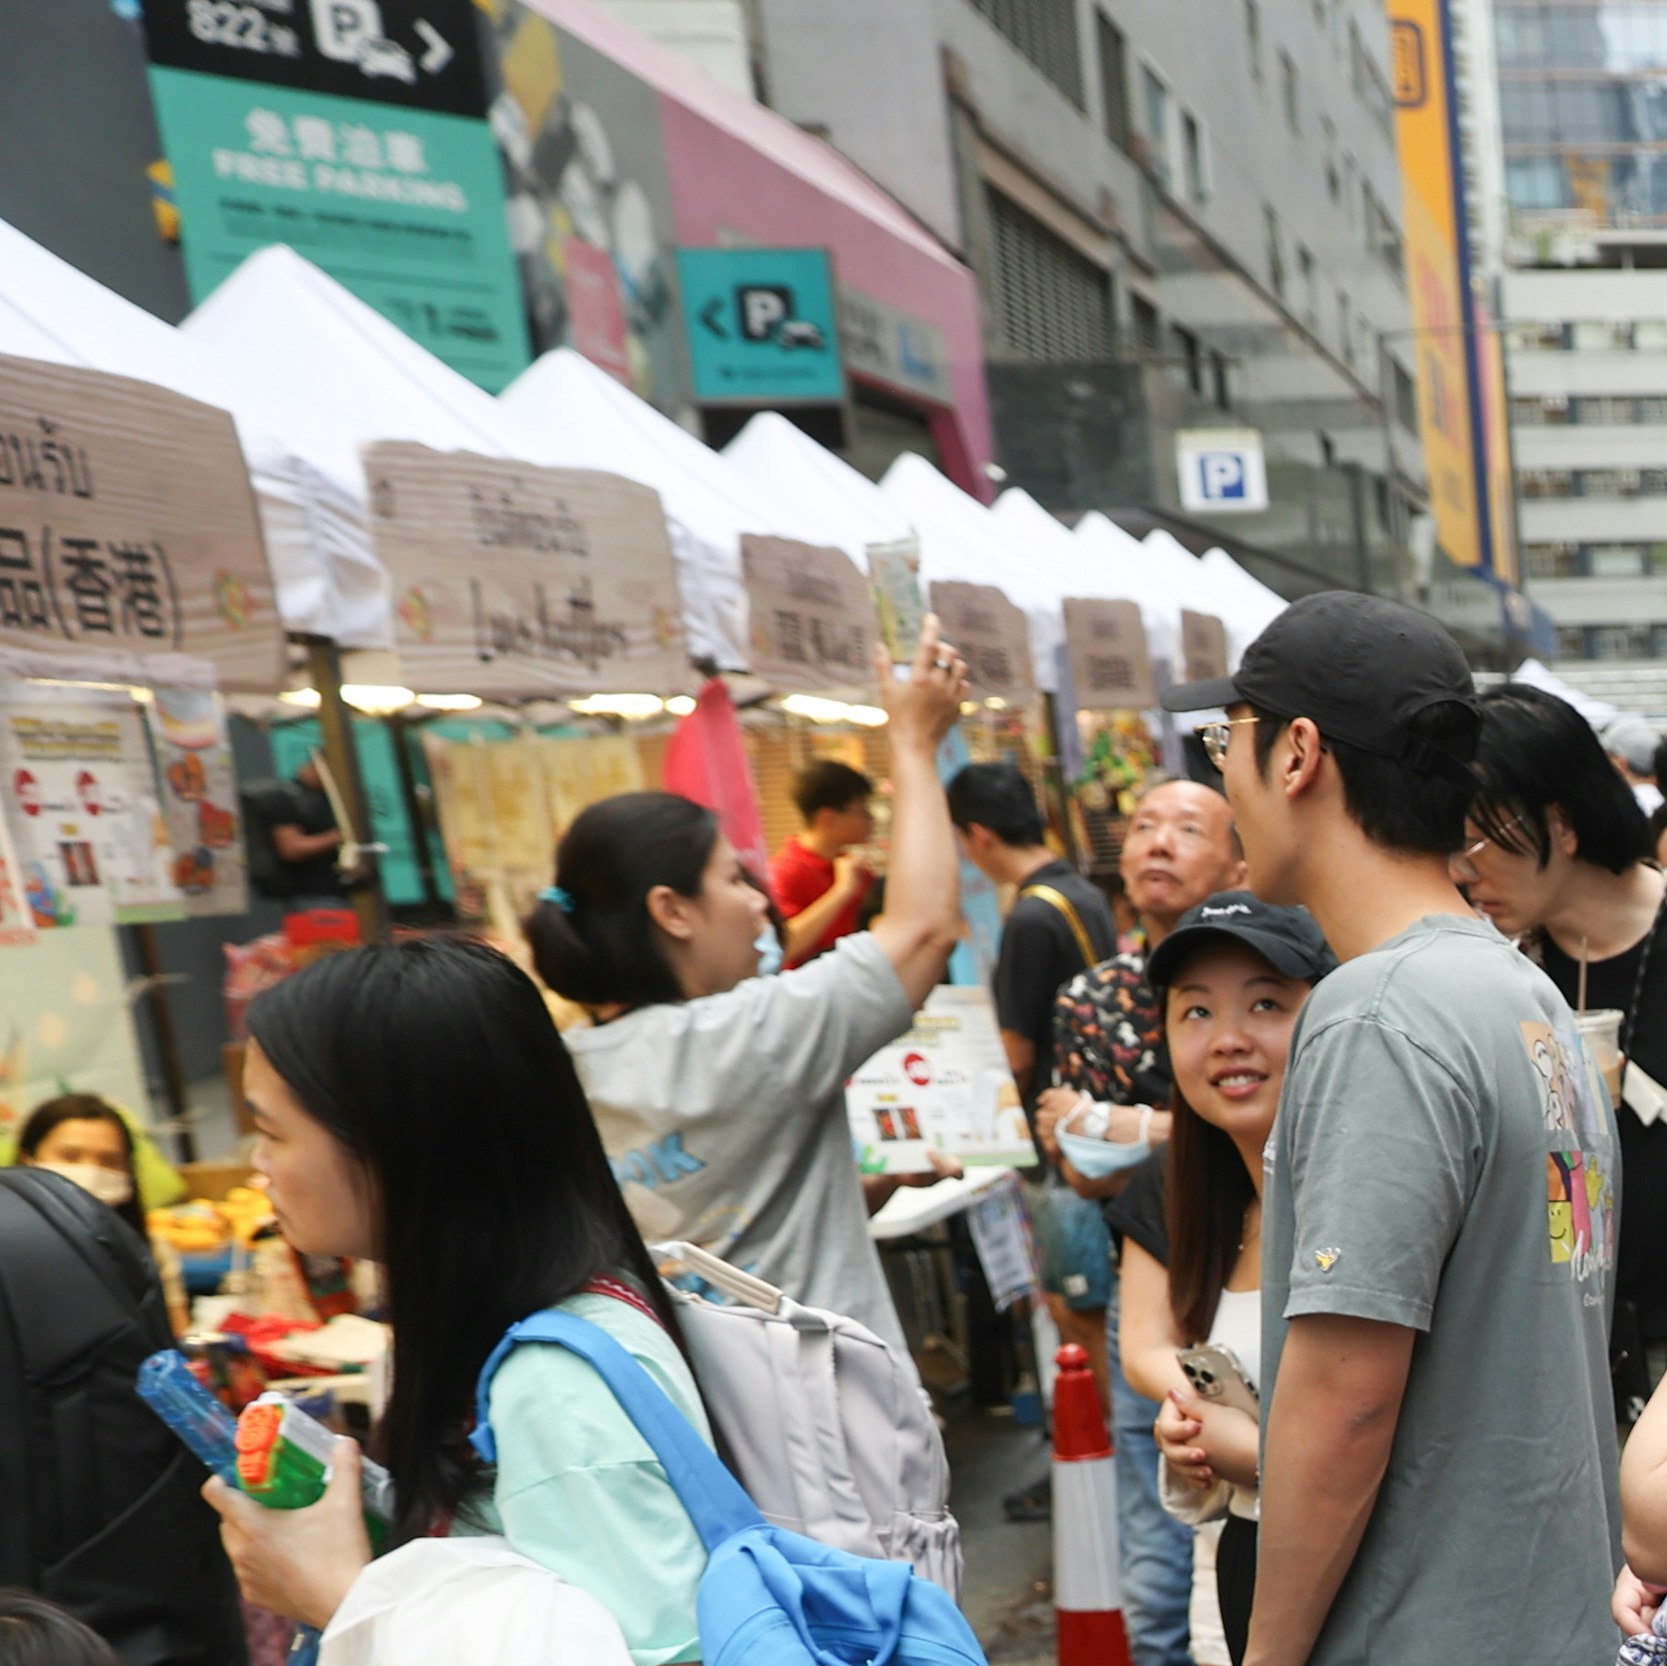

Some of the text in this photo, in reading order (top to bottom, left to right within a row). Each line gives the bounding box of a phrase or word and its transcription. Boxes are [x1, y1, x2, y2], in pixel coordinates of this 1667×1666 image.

[211, 148, 469, 213] FREE PARKING
[742, 289, 787, 338] P
[1207, 456, 1242, 499] P
